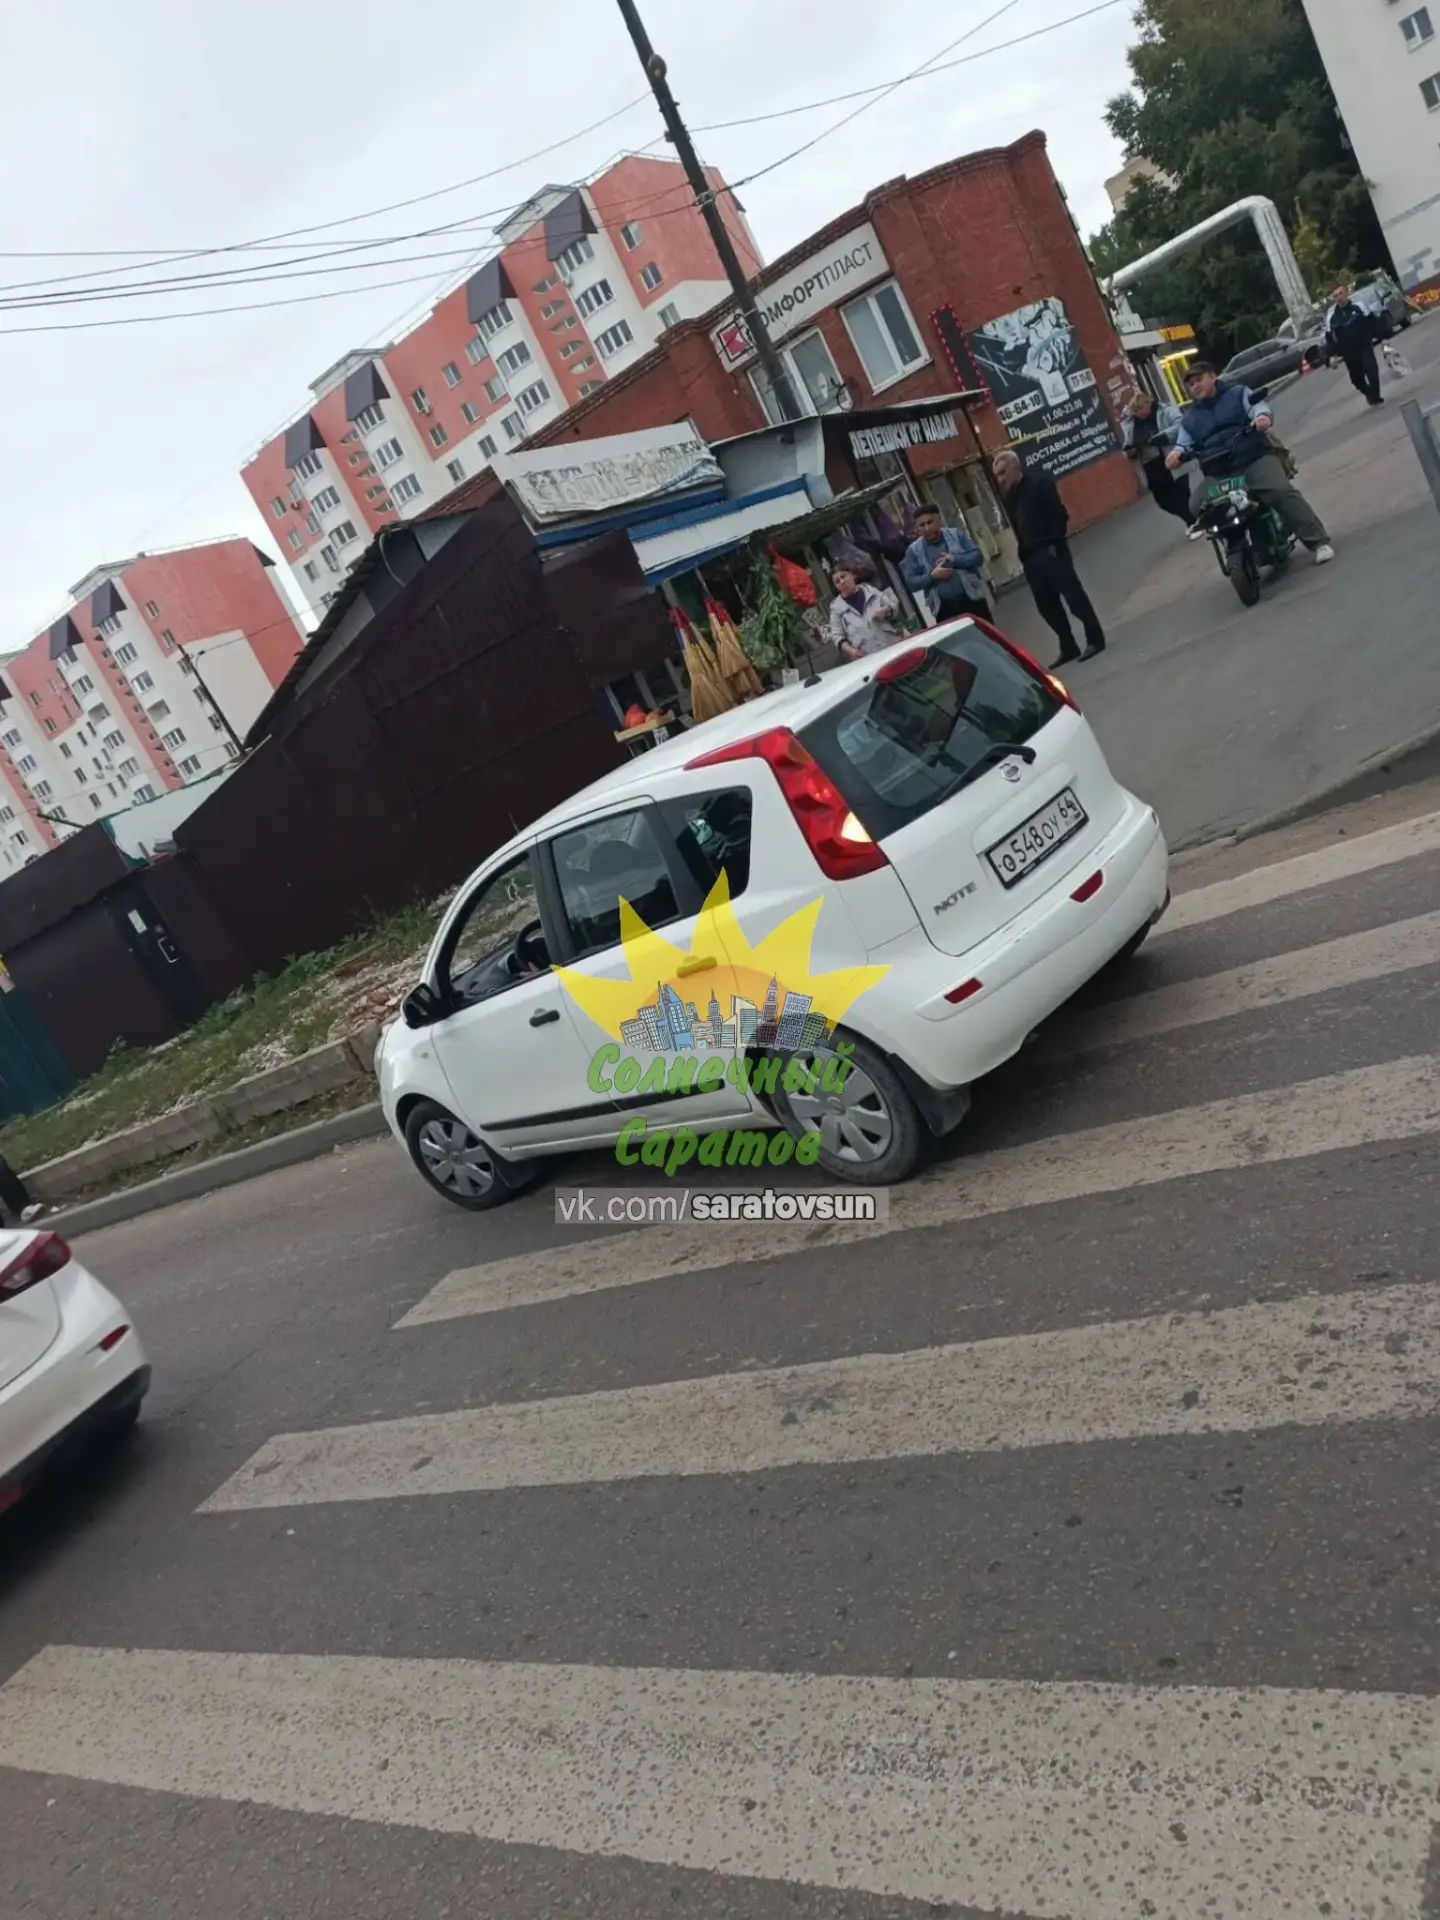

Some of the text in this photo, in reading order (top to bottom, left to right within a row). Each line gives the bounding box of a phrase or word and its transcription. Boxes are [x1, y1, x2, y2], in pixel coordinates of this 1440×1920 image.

[849, 422, 912, 459] ЛЕПЕШКИ
[1025, 437, 1072, 467] ДОСТАВКА
[933, 881, 977, 916] NOTE
